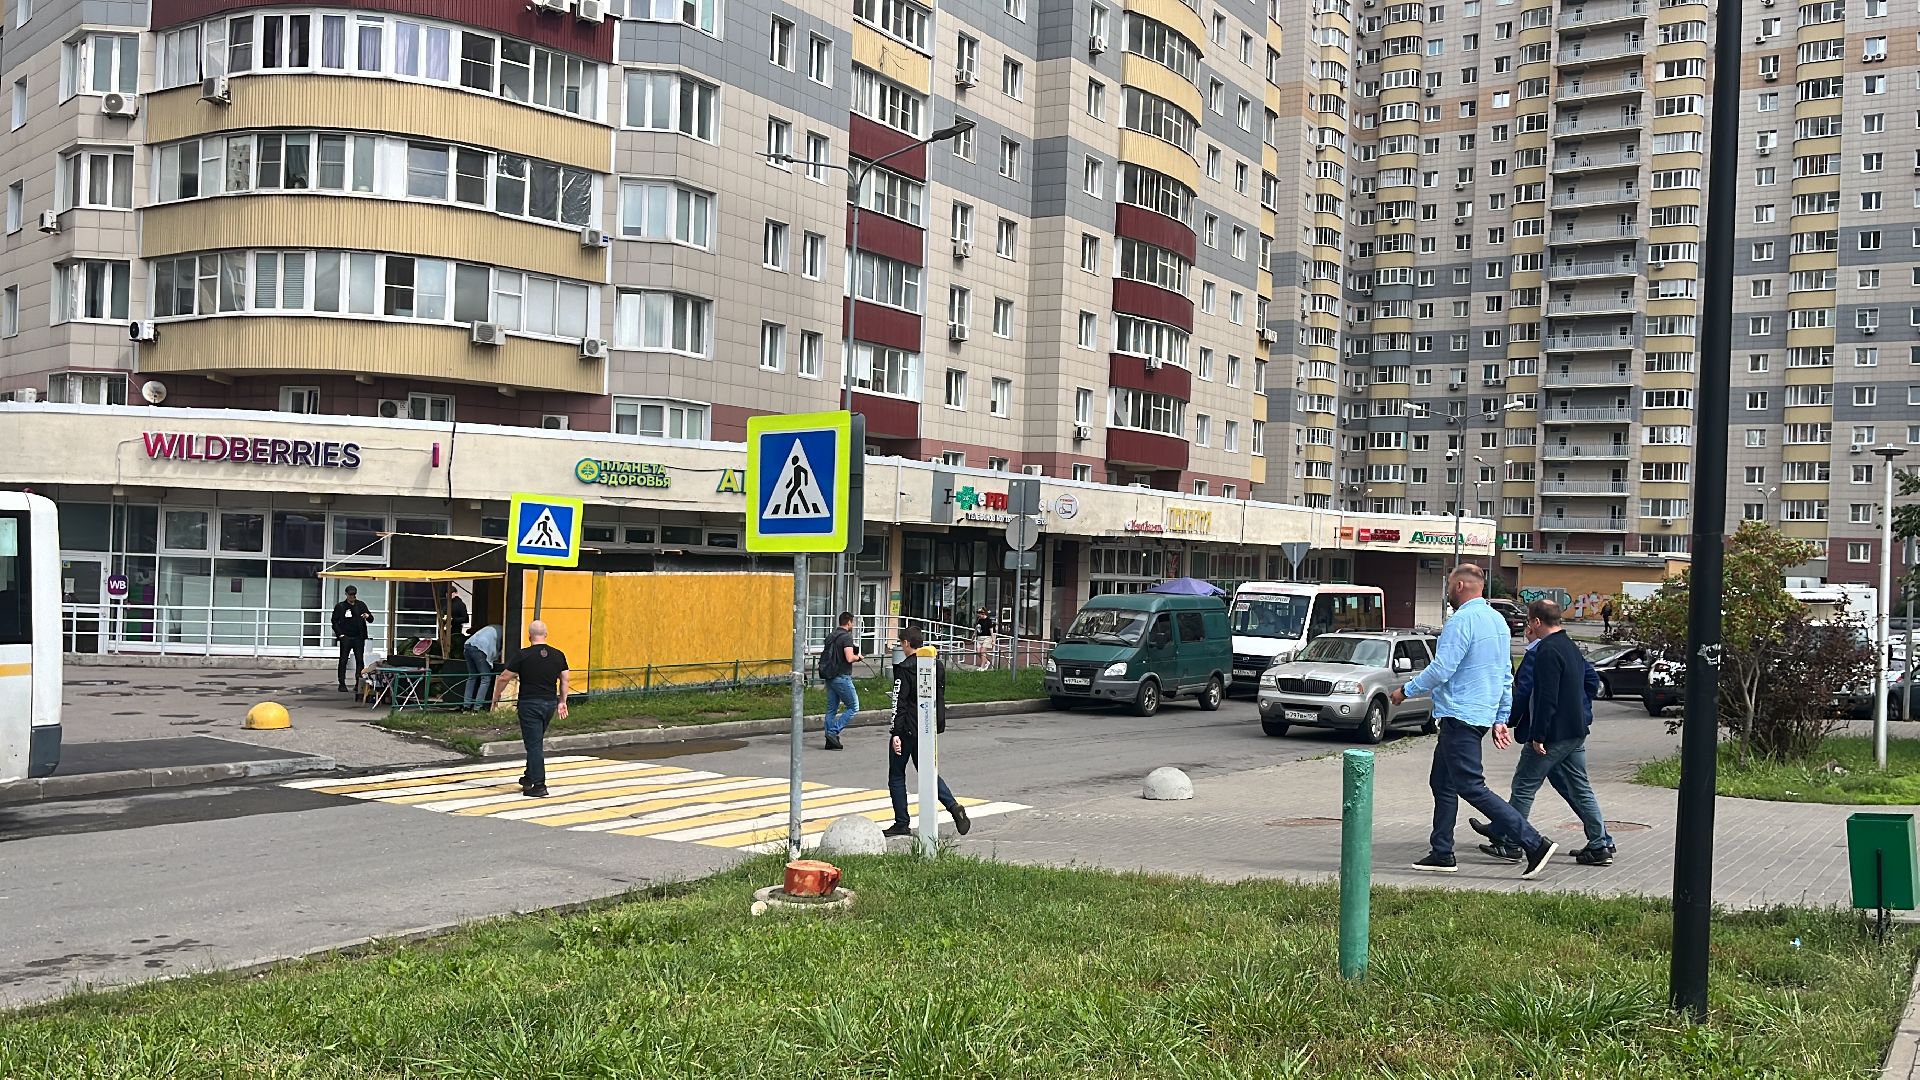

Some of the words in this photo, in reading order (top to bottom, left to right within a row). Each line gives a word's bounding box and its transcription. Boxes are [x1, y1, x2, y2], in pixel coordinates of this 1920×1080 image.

[142, 432, 362, 469] WILDBERRIES
[600, 460, 667, 476] ПЛАНЕТА
[600, 474, 672, 489] ЗДОРОВЬЯ
[109, 580, 127, 590] WB
